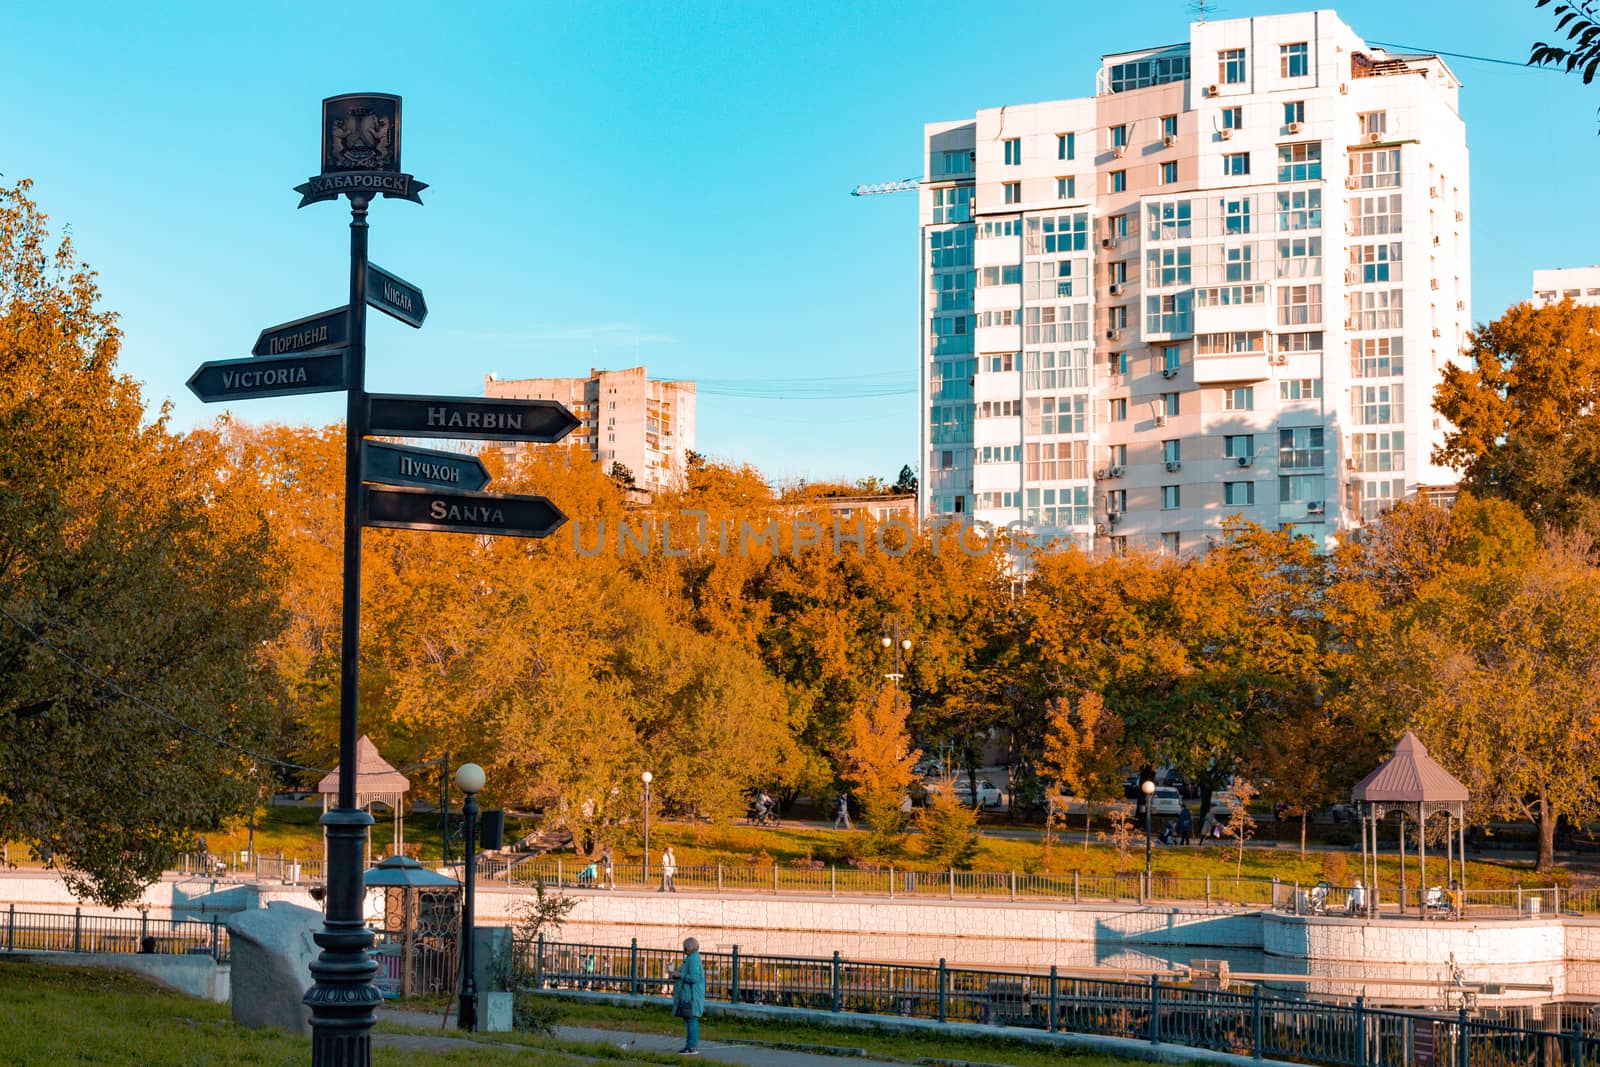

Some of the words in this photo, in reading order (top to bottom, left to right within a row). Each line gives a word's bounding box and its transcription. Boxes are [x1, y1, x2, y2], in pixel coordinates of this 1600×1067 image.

[223, 367, 308, 389] VICTORIA
[427, 407, 523, 430] HARBIN
[430, 500, 505, 523] SANYA
